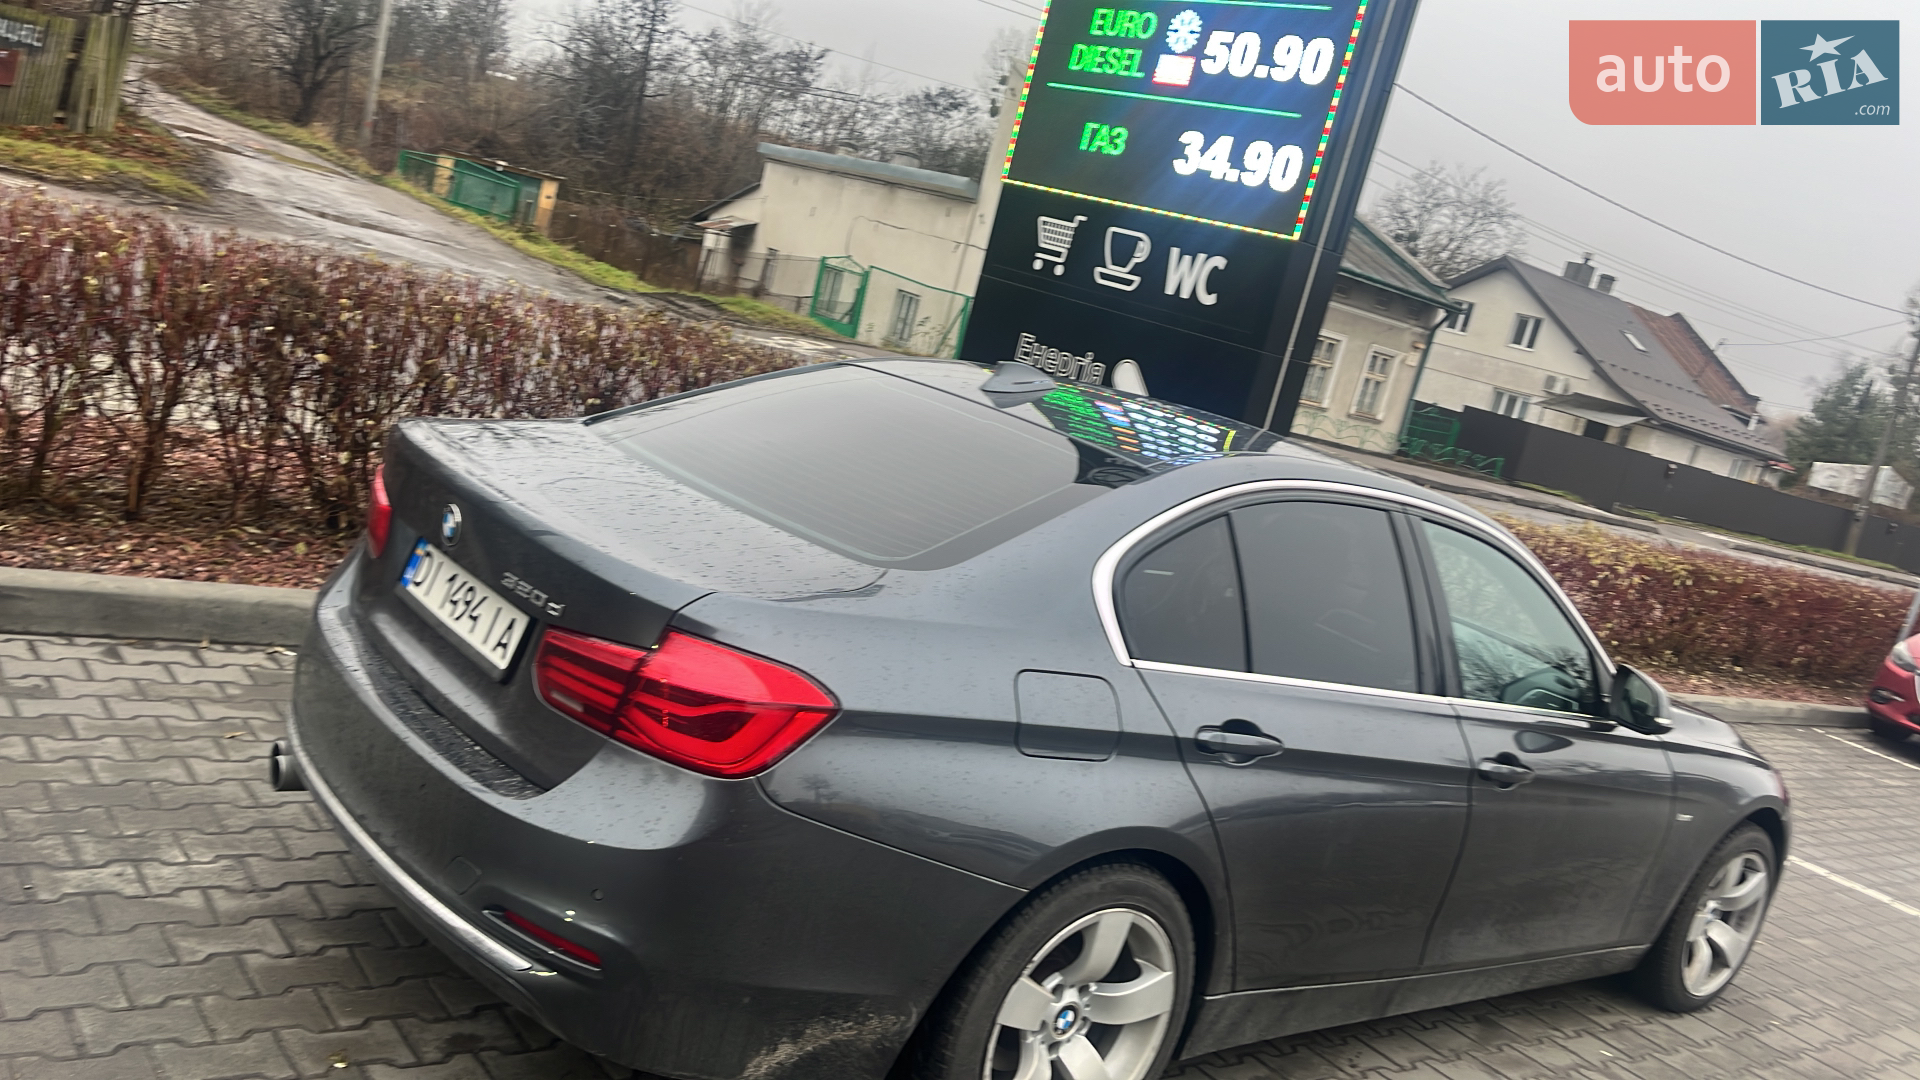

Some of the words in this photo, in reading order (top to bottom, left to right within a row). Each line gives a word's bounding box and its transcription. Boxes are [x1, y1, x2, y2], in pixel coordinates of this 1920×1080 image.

[1090, 8, 1158, 40] EURO
[1068, 43, 1145, 78] DIESEL
[1200, 30, 1335, 86] 50.90
[1079, 122, 1129, 156] ГАЗ
[1172, 130, 1304, 192] 34.90
[1164, 247, 1228, 306] WC
